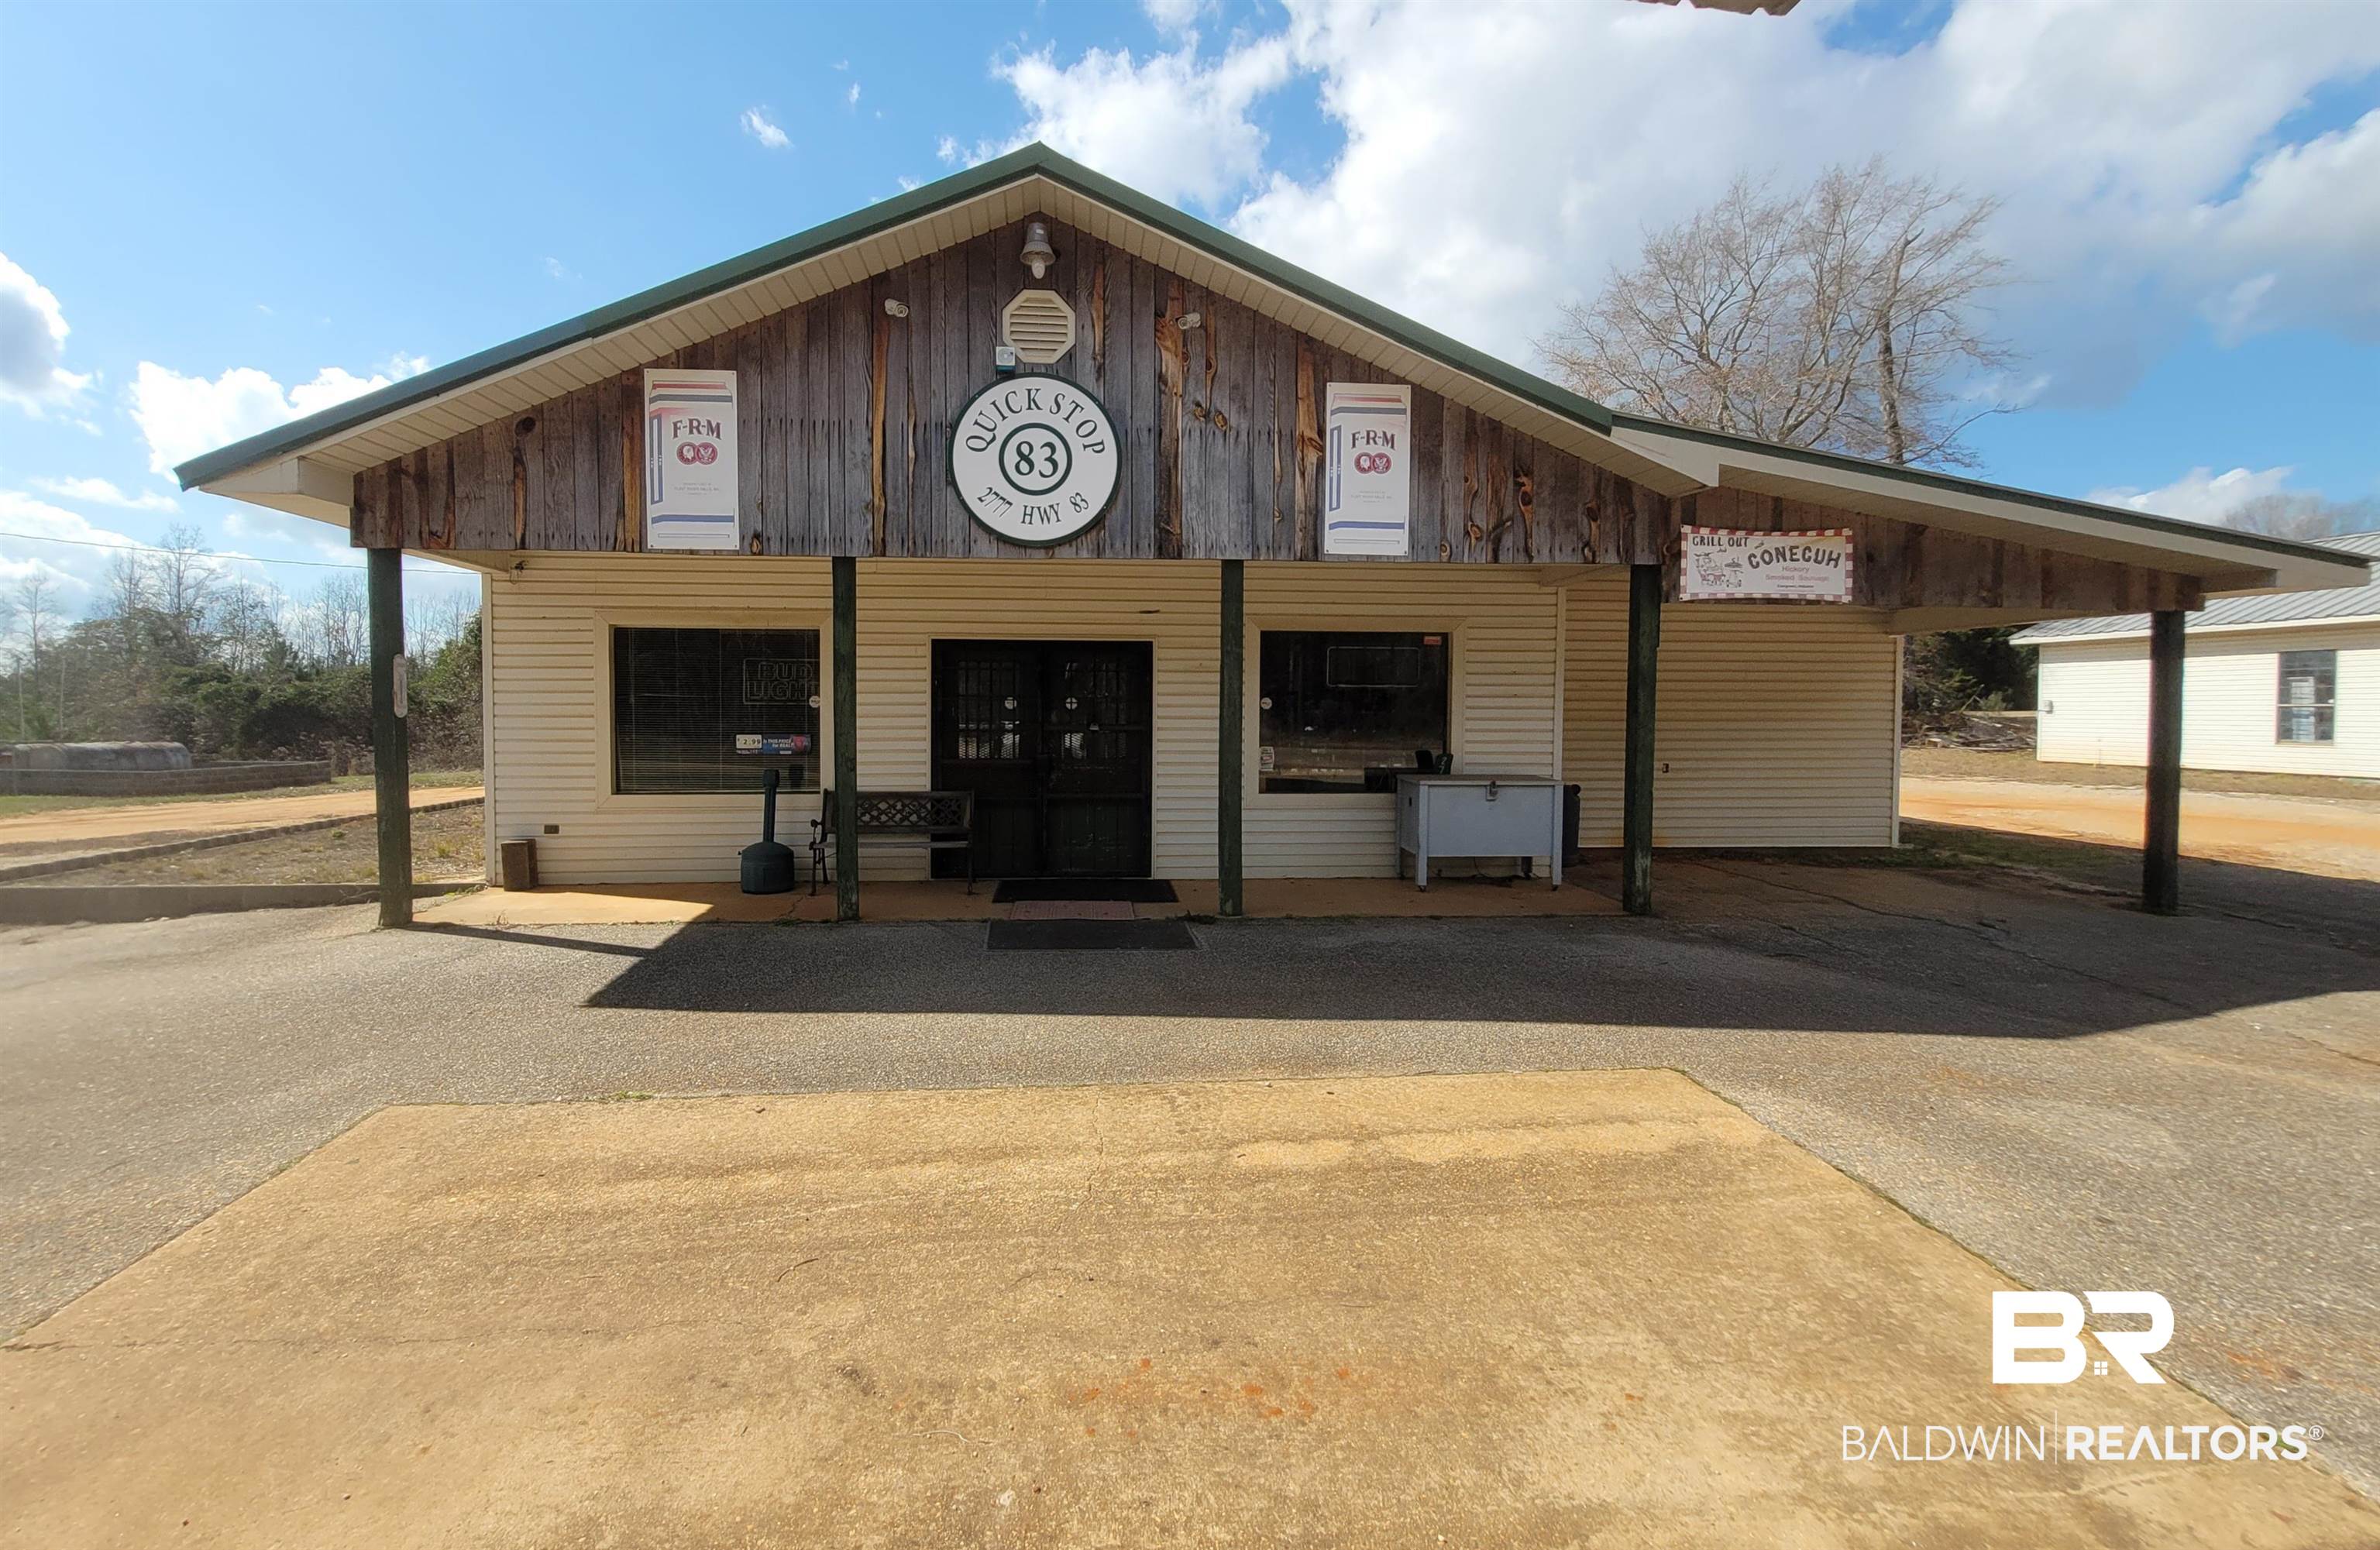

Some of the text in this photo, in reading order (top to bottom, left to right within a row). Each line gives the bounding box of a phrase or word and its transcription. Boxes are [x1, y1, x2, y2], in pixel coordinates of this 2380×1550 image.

[965, 388, 1106, 454] QUICK STOP
[1014, 440, 1059, 478] 83
[1020, 503, 1062, 525] HWY
[1069, 492, 1089, 514] 83
[1692, 535, 1724, 547] GRILL
[1728, 536, 1749, 548] OUT
[1782, 565, 1810, 574] Hickory
[758, 662, 813, 681] BUD
